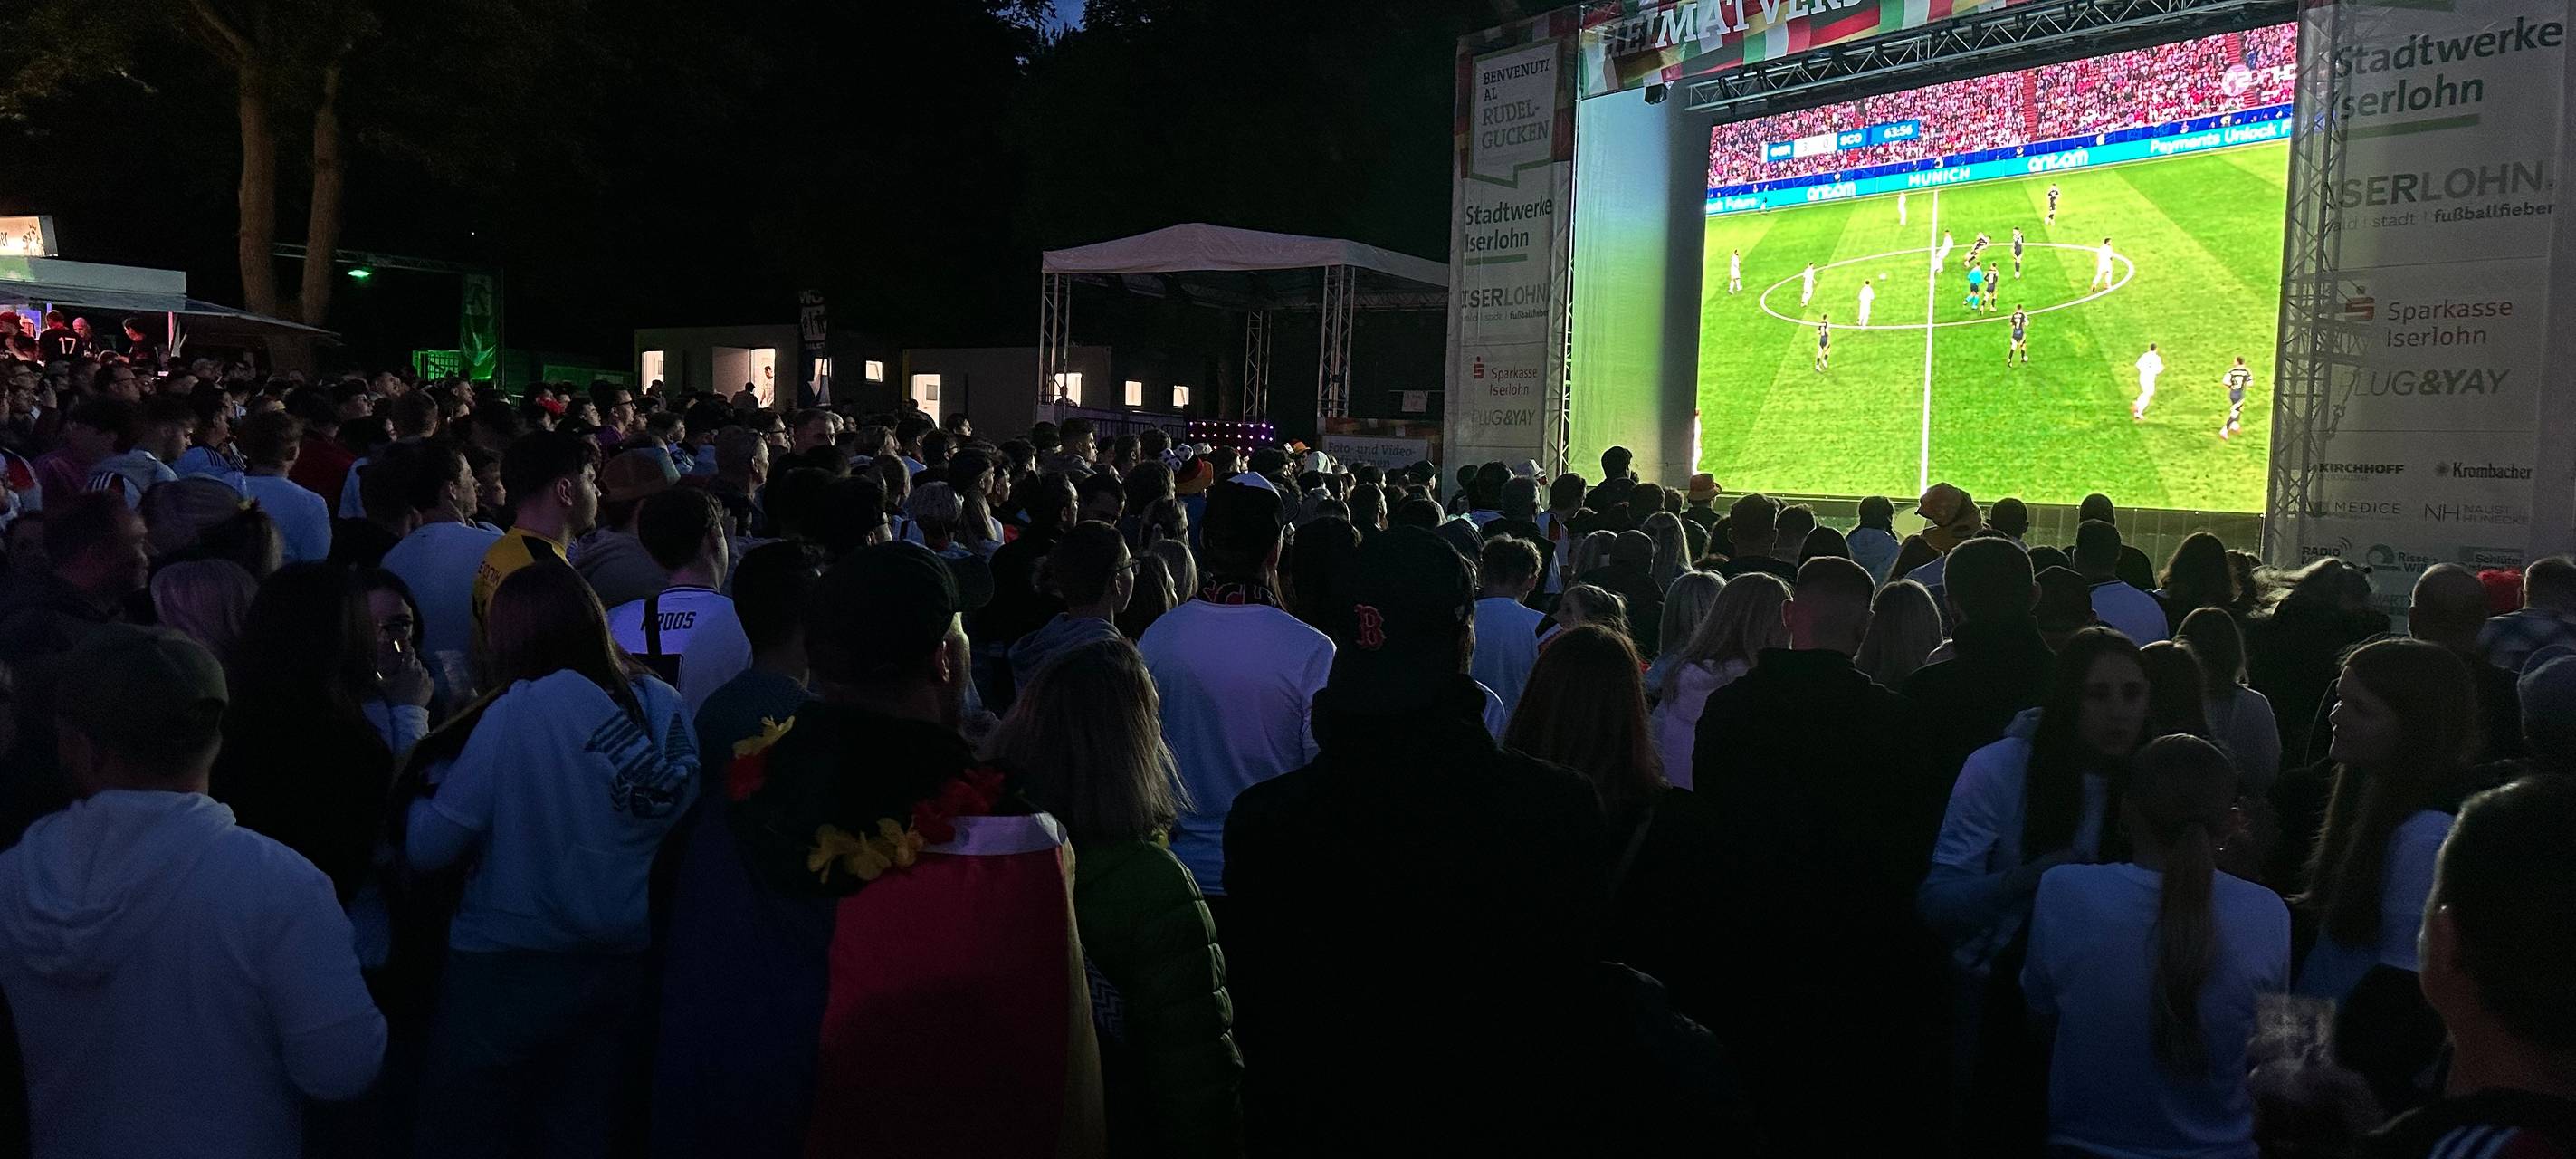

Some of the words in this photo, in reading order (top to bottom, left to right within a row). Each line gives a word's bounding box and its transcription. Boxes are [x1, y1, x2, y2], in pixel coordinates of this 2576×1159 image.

[2335, 16, 2564, 79] Stadtwerke
[1483, 59, 1550, 85] BENVENUTI
[1484, 88, 1497, 101] AL
[2338, 73, 2484, 120] serlohn
[1482, 99, 1541, 126] RUDEL-
[1481, 120, 1550, 149] GUCKEN
[1908, 168, 1970, 187] MUNICH
[2150, 131, 2221, 155] Payments
[2224, 121, 2277, 144] Unlock
[2339, 160, 2554, 208] SERLOHN.
[1465, 195, 1553, 226] Stadtwerke
[2435, 202, 2555, 223] fußballfieber
[1465, 227, 1529, 253] Iserlohn
[2387, 299, 2514, 325] Sparkasse
[58, 336, 77, 355] 17
[2387, 326, 2487, 348] Iserlohn
[1491, 364, 1538, 380] Sparkasse
[1489, 382, 1530, 397] Iserlohn
[2319, 463, 2405, 474] KIRCHHOFF
[2453, 462, 2532, 480] Krombacher
[2335, 502, 2402, 514] MEDICE
[2425, 503, 2460, 522] NH
[2302, 546, 2341, 557] RADIO
[641, 611, 697, 631] ROOS
[1355, 604, 1387, 651] B
